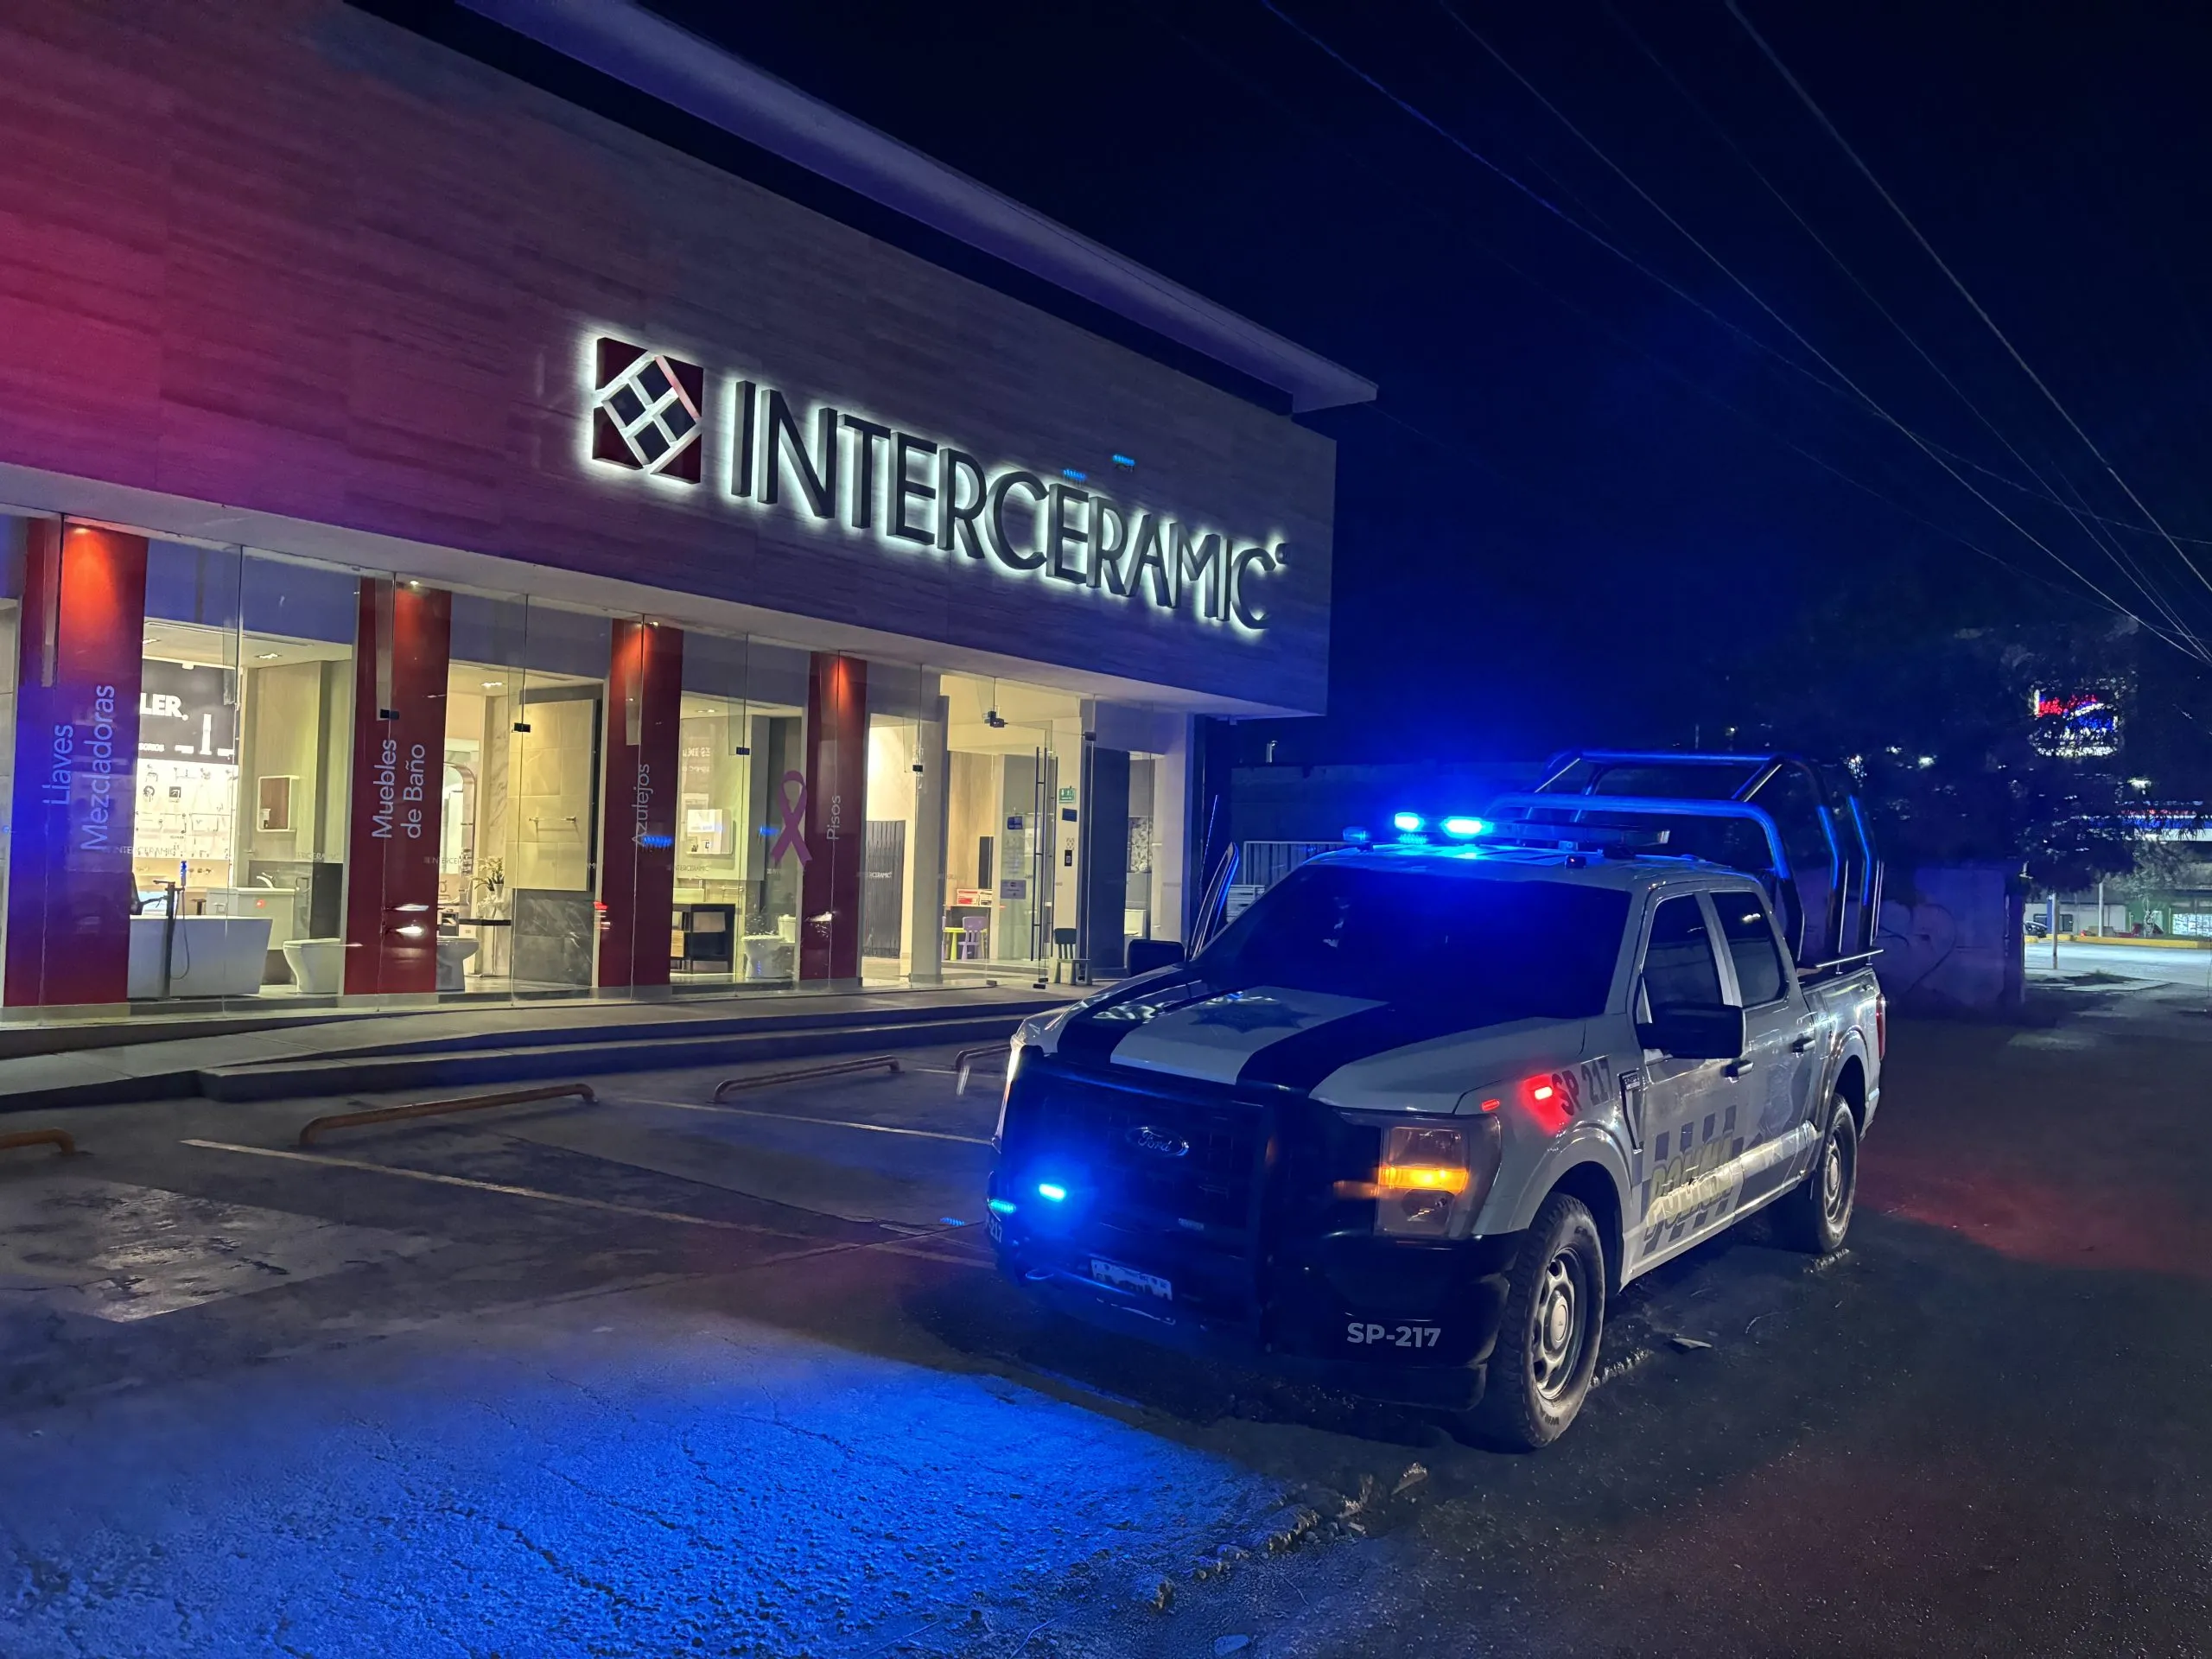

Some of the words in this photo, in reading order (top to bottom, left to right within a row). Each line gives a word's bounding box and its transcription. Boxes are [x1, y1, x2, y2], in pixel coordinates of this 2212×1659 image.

[732, 380, 1276, 629] INTERCERAMIC
[41, 724, 73, 805] Llaves
[80, 684, 115, 851] Mezcladoras
[372, 739, 397, 838] Muebles
[403, 744, 425, 802] Baño
[400, 808, 423, 839] de
[631, 763, 653, 848] Azulejos
[826, 795, 841, 840] Pisos
[1551, 1070, 1582, 1116] SP
[1580, 1057, 1614, 1107] 217
[1137, 1129, 1172, 1152] Ford
[1346, 1322, 1441, 1348] SP-217
